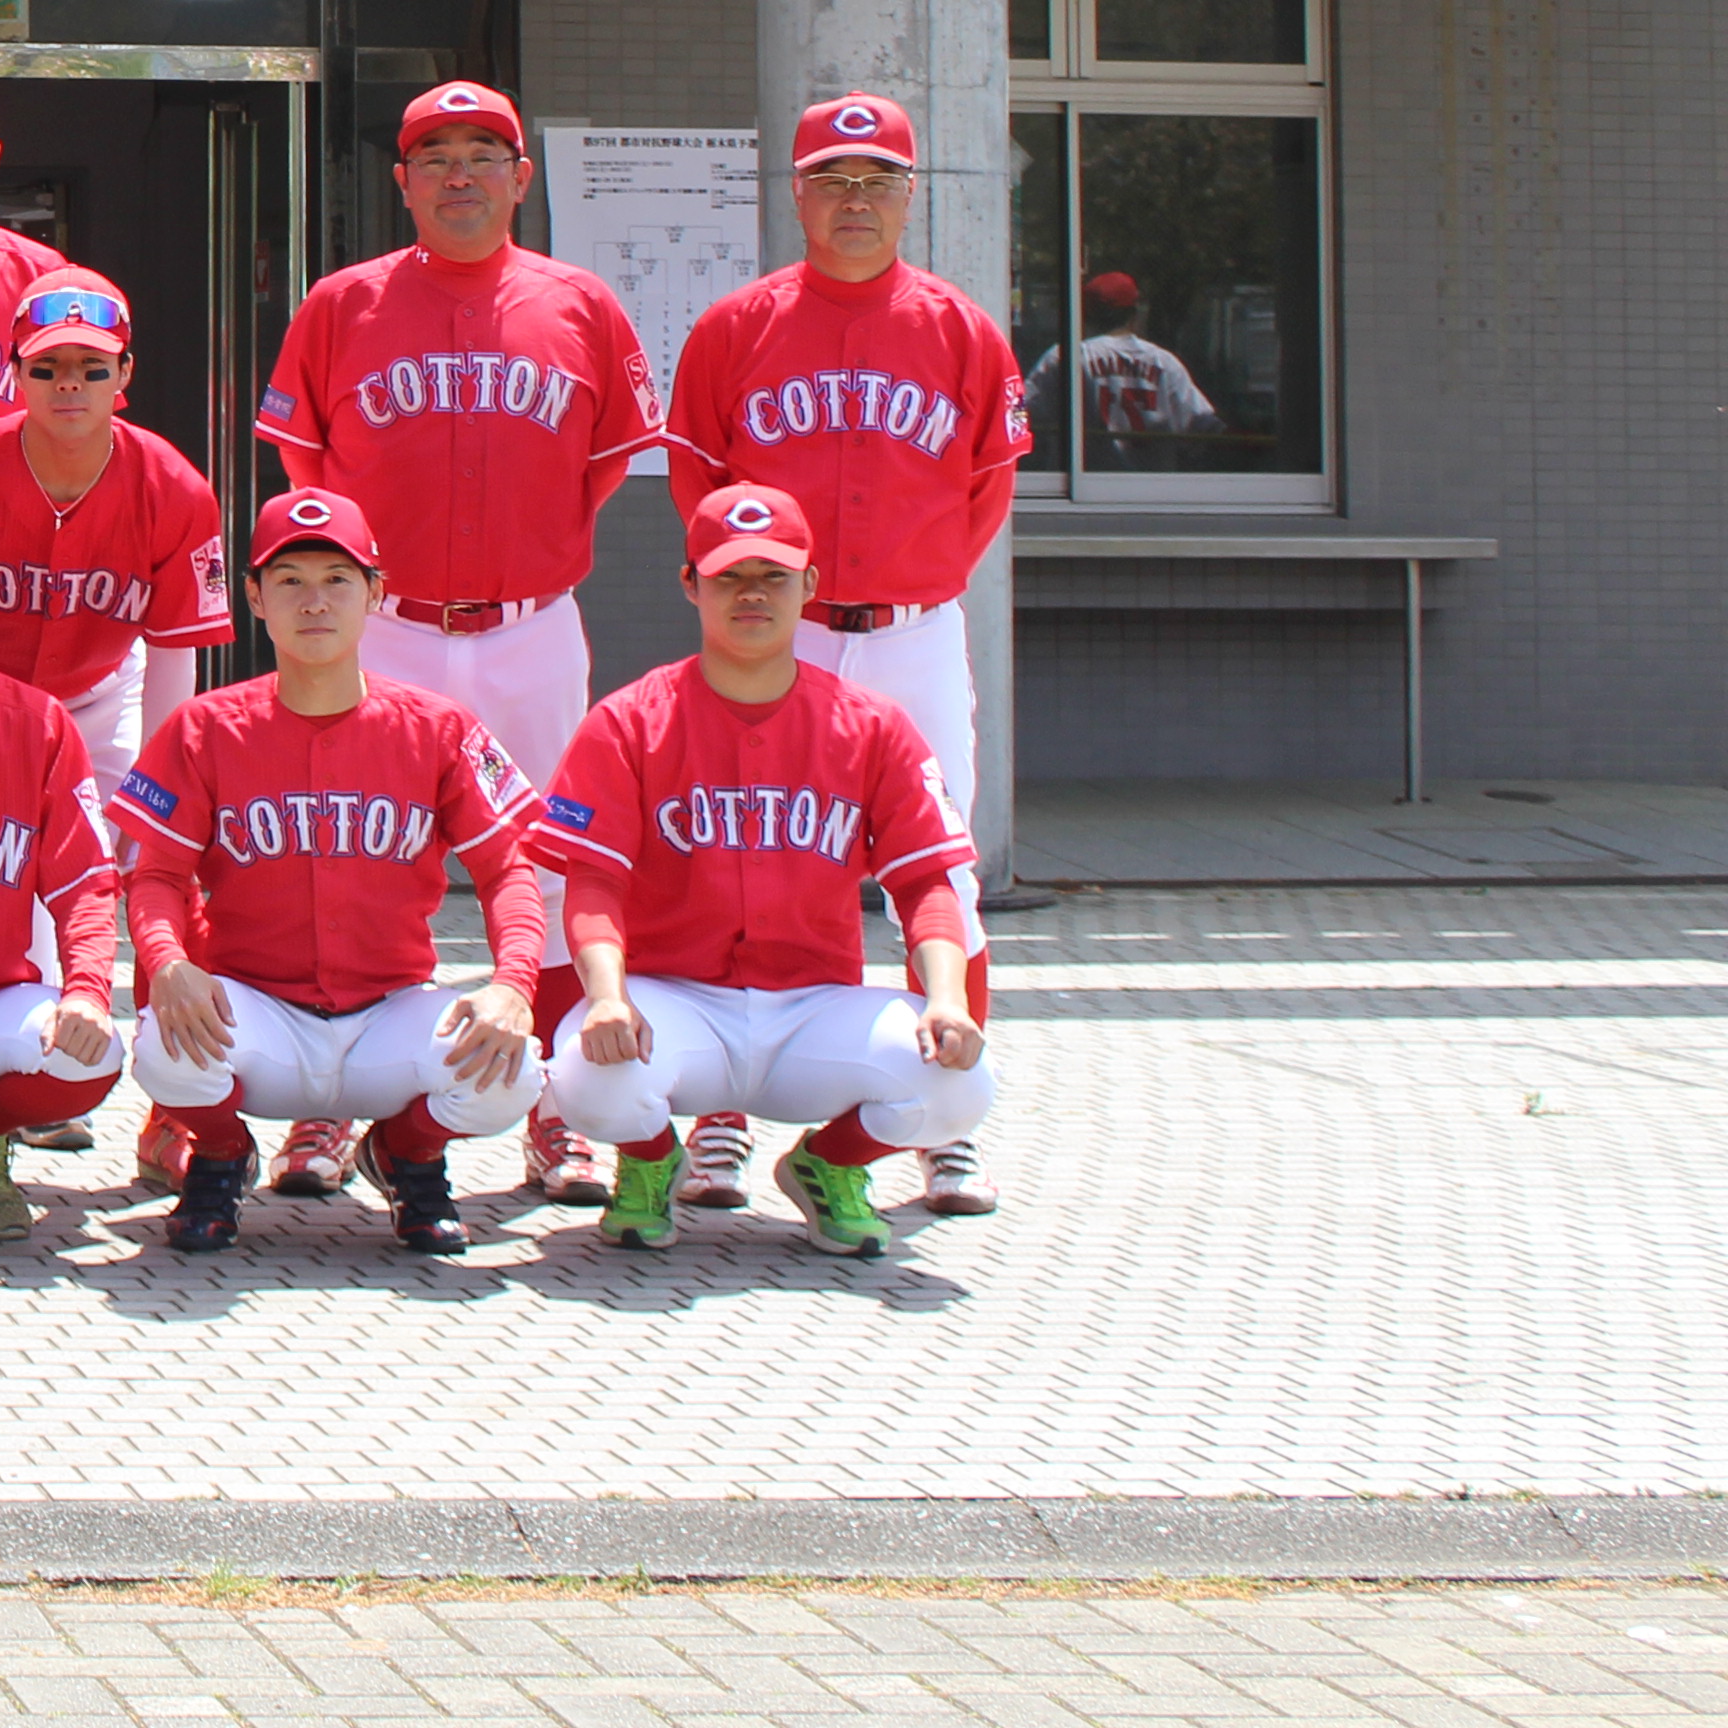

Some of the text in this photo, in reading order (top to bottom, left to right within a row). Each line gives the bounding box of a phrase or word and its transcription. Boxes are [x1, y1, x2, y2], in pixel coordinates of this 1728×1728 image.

[355, 352, 578, 436] COTTON
[743, 368, 964, 460] COTTON
[214, 790, 441, 866] COTTON
[656, 783, 864, 866] COTTON
